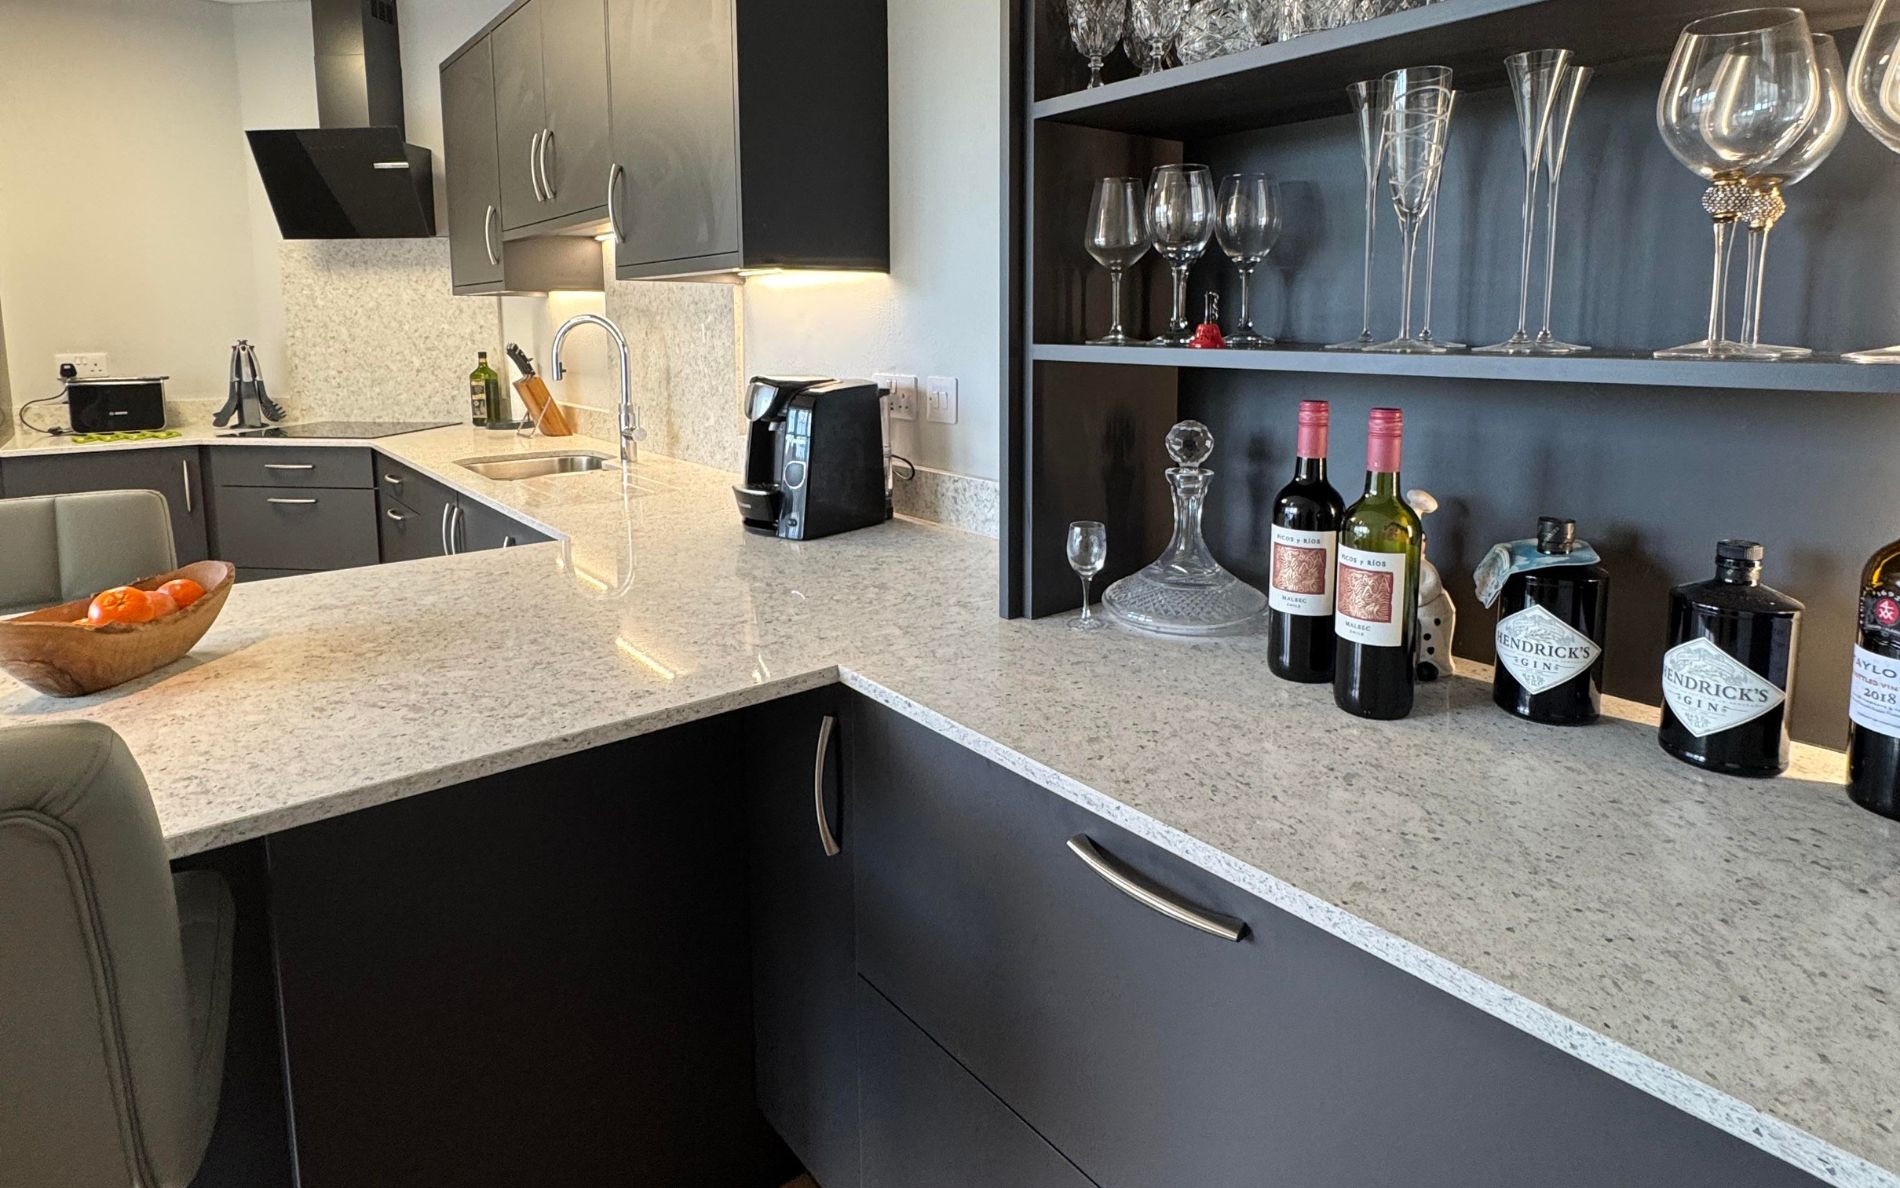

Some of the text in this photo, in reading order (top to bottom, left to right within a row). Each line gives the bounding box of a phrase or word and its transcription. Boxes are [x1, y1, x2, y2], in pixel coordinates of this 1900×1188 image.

[1282, 595, 1307, 603] MALBEC
[1345, 621, 1371, 631] MALBEC
[1497, 631, 1590, 659] HENDRICK'S
[1521, 658, 1552, 671] GIN
[1684, 695, 1719, 712] GIN
[1863, 687, 1897, 705] 2018
